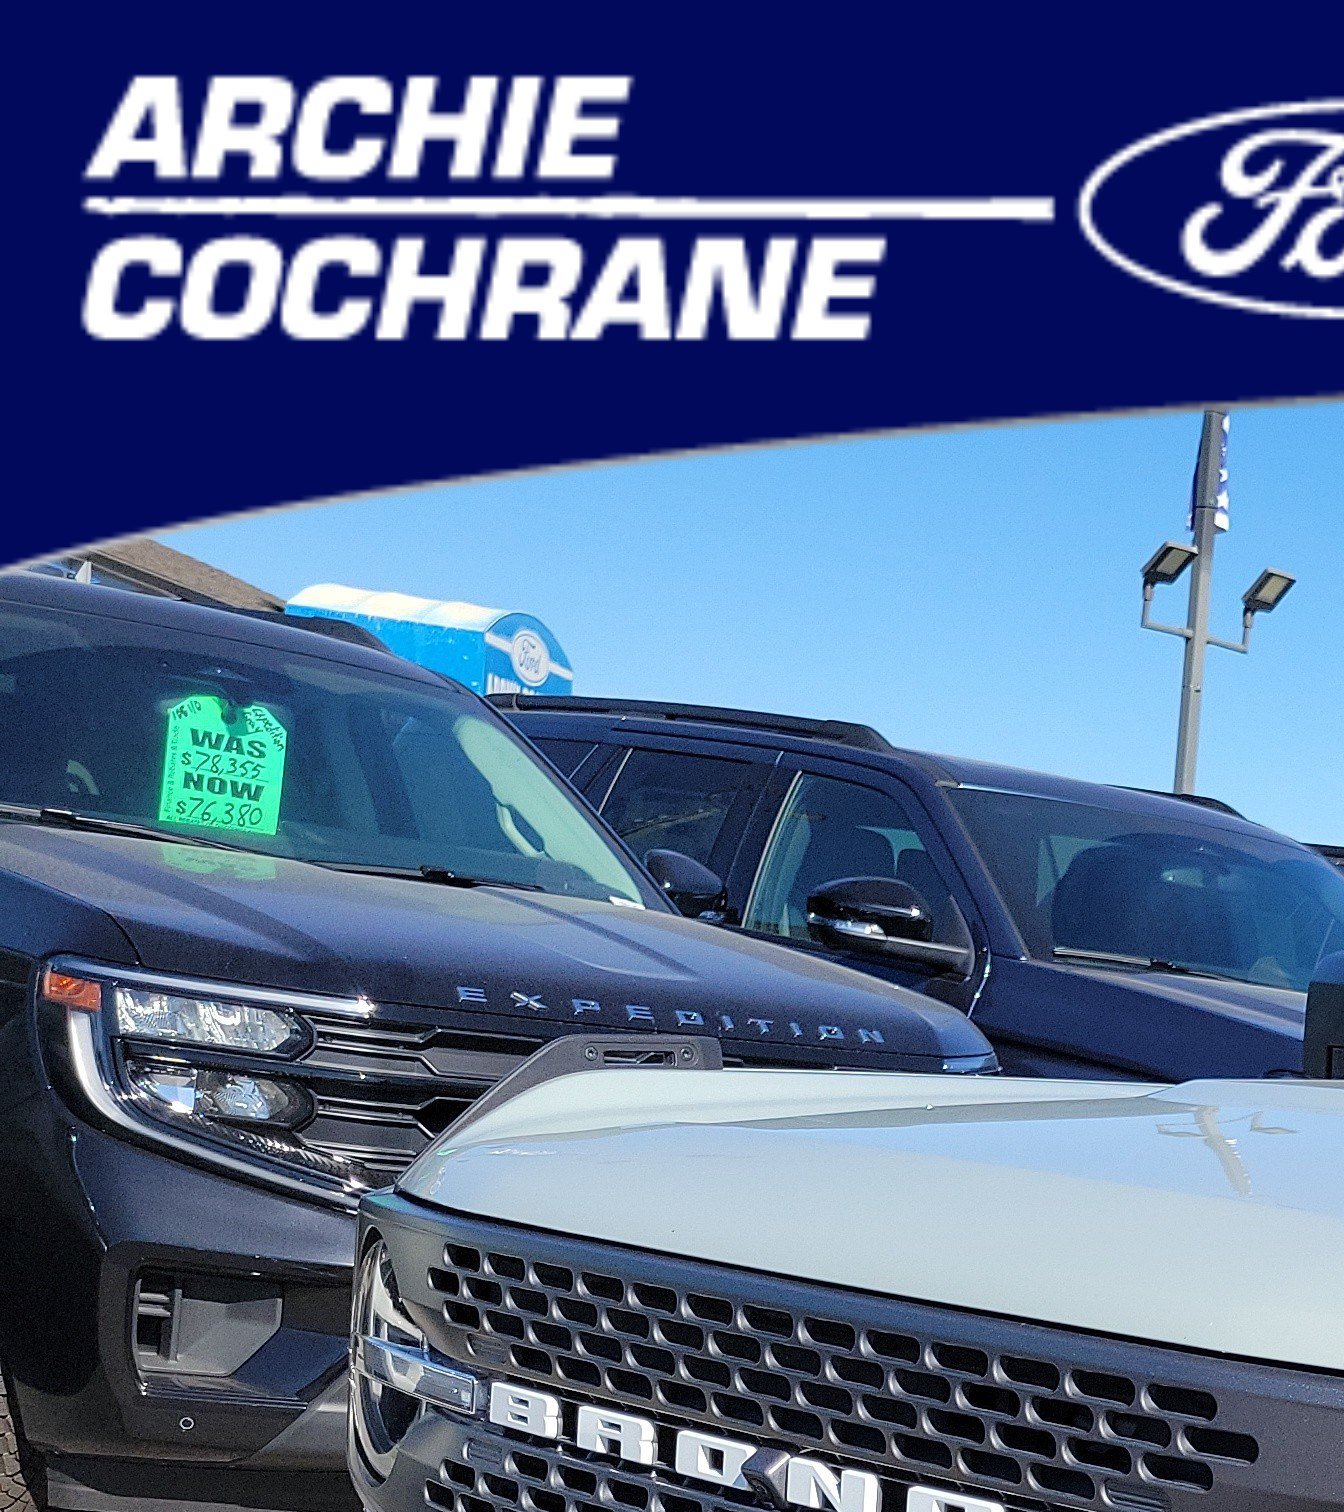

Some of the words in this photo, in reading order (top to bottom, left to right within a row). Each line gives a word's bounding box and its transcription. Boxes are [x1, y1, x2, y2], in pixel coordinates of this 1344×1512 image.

[190, 727, 267, 759] WAS
[181, 751, 266, 779] $78,355
[183, 770, 265, 802] NOW
[175, 796, 263, 828] $76,380
[455, 985, 885, 1044] EXPEDITION
